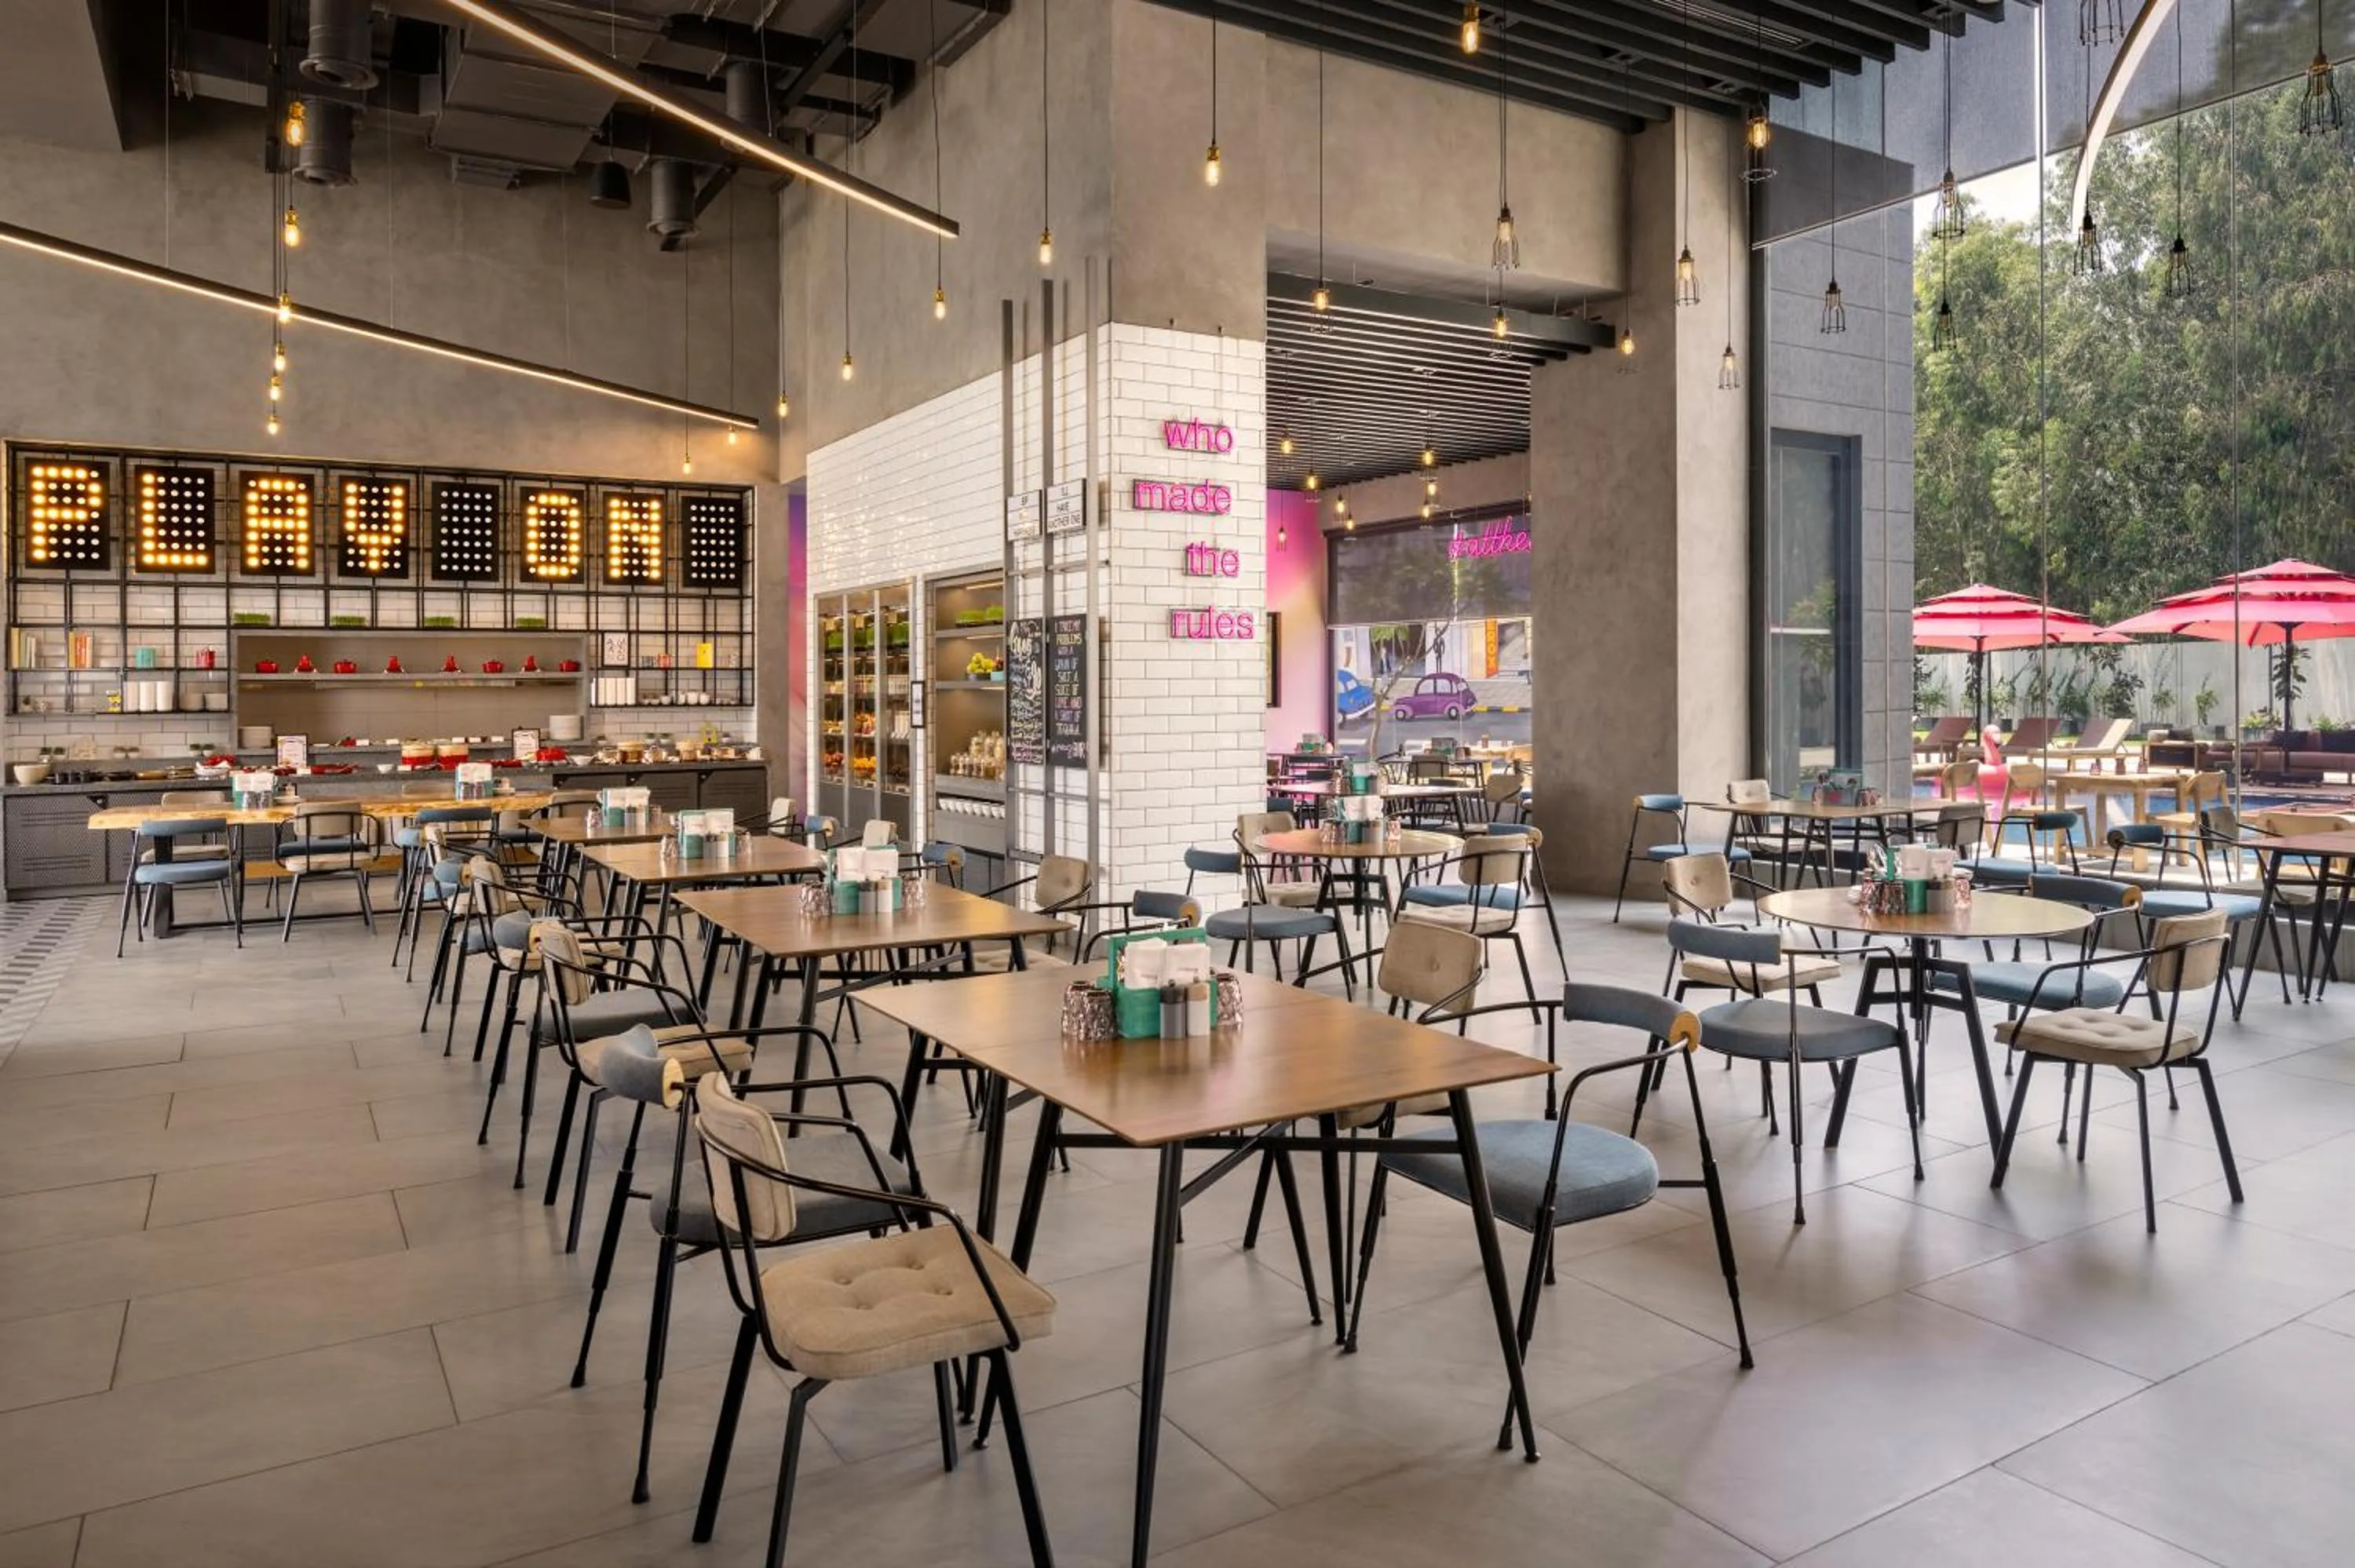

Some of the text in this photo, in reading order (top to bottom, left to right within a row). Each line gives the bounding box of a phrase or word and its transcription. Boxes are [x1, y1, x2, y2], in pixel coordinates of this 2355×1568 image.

[1163, 418, 1233, 454] who
[1134, 479, 1232, 515] made
[31, 465, 661, 579] PLAY ON
[1185, 541, 1240, 578] the
[1170, 605, 1254, 640] rules
